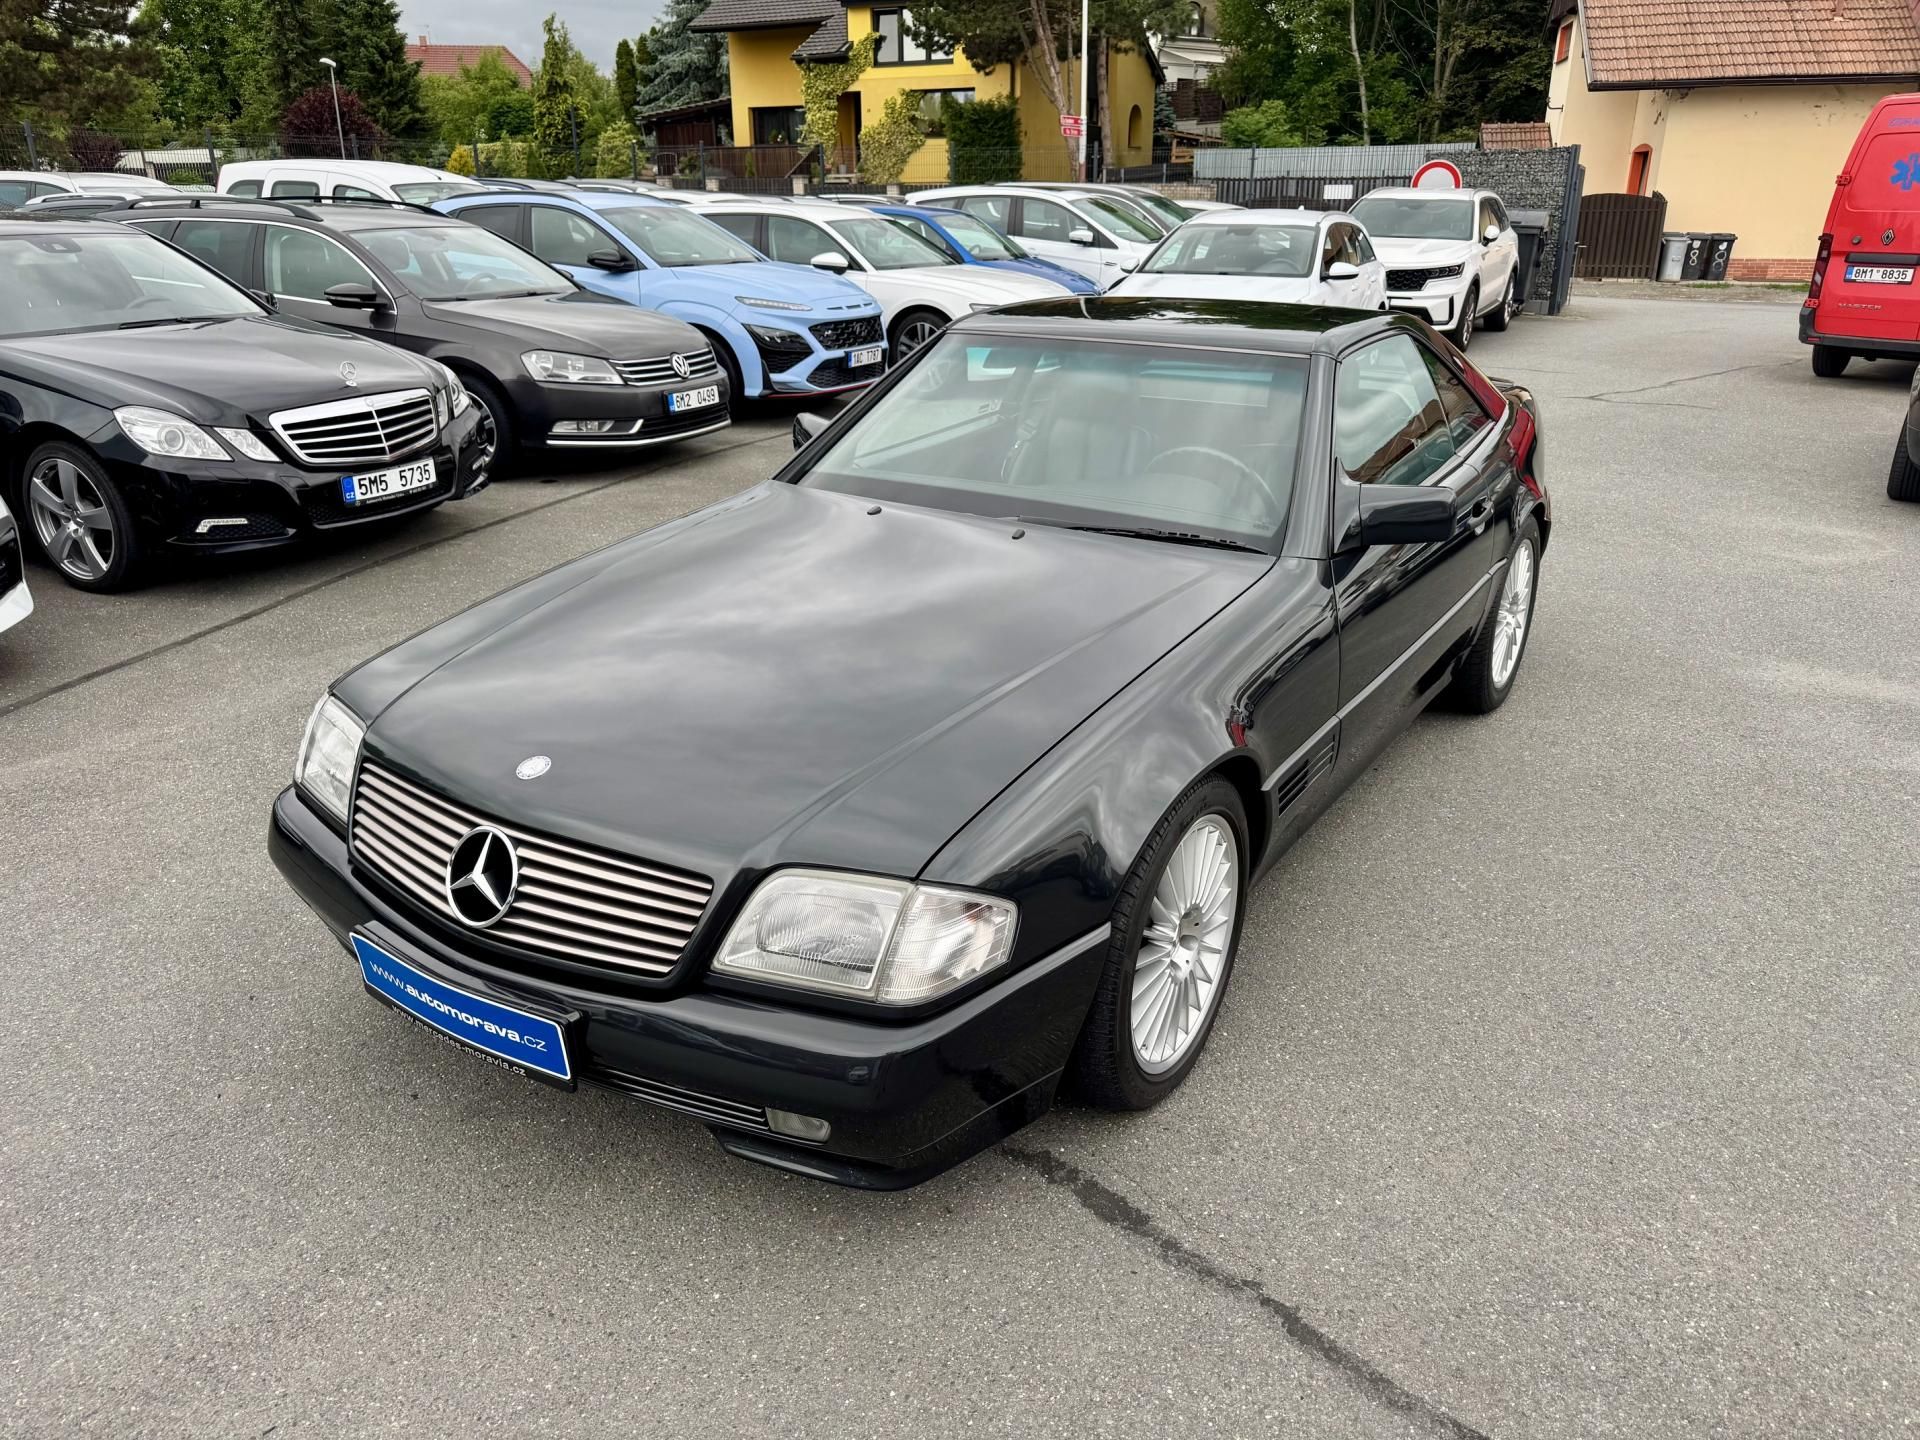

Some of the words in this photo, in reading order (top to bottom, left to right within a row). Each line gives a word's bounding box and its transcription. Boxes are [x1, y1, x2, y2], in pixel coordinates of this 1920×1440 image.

[1854, 268, 1874, 279] 8M1
[1881, 269, 1909, 280] 8835
[675, 393, 692, 408] 6M2
[696, 388, 715, 405] 0499
[357, 473, 389, 496] 5M5
[399, 463, 431, 487] 5735
[345, 491, 356, 499] CZ
[369, 960, 548, 1053] www.automorava.cz
[391, 1005, 527, 1077] www.mercedes-moravia.cz
